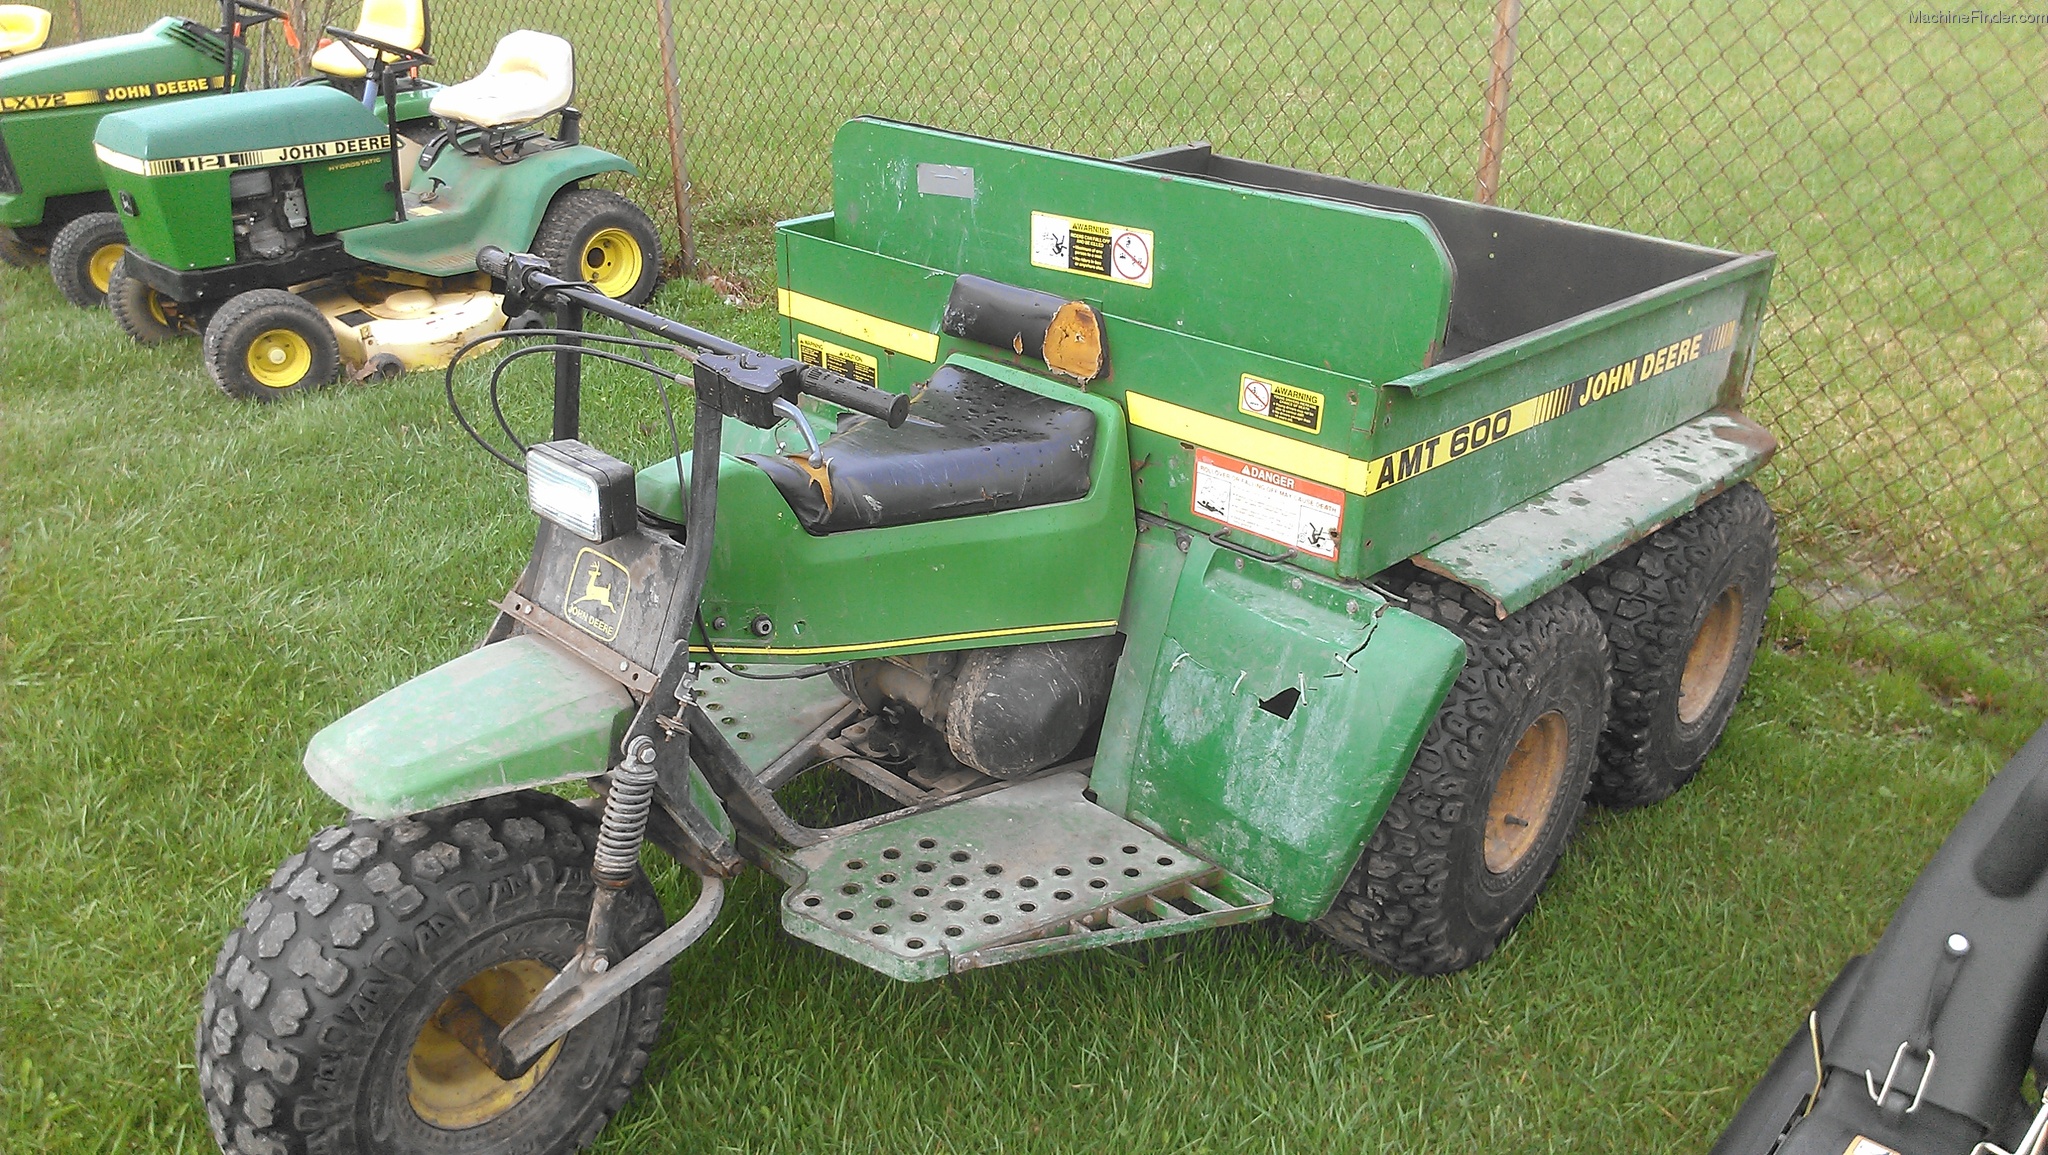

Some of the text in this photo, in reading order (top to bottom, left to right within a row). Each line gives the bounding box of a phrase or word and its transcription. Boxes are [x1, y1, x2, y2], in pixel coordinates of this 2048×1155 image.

[105, 78, 209, 102] JOHN DEERE
[1, 94, 66, 111] LX172
[279, 136, 390, 161] JOHN DEERE
[328, 157, 381, 172] HYDROSTATIC
[1077, 222, 1110, 236] WARNING
[844, 351, 863, 362] CAUTION
[1579, 333, 1703, 407] JOHN DEERE
[1279, 386, 1318, 404] WARNING
[1376, 409, 1511, 490] AMT 600
[1251, 466, 1295, 489] DANGER
[1316, 501, 1337, 513] DEATH
[568, 602, 614, 636] JOHN DEERE
